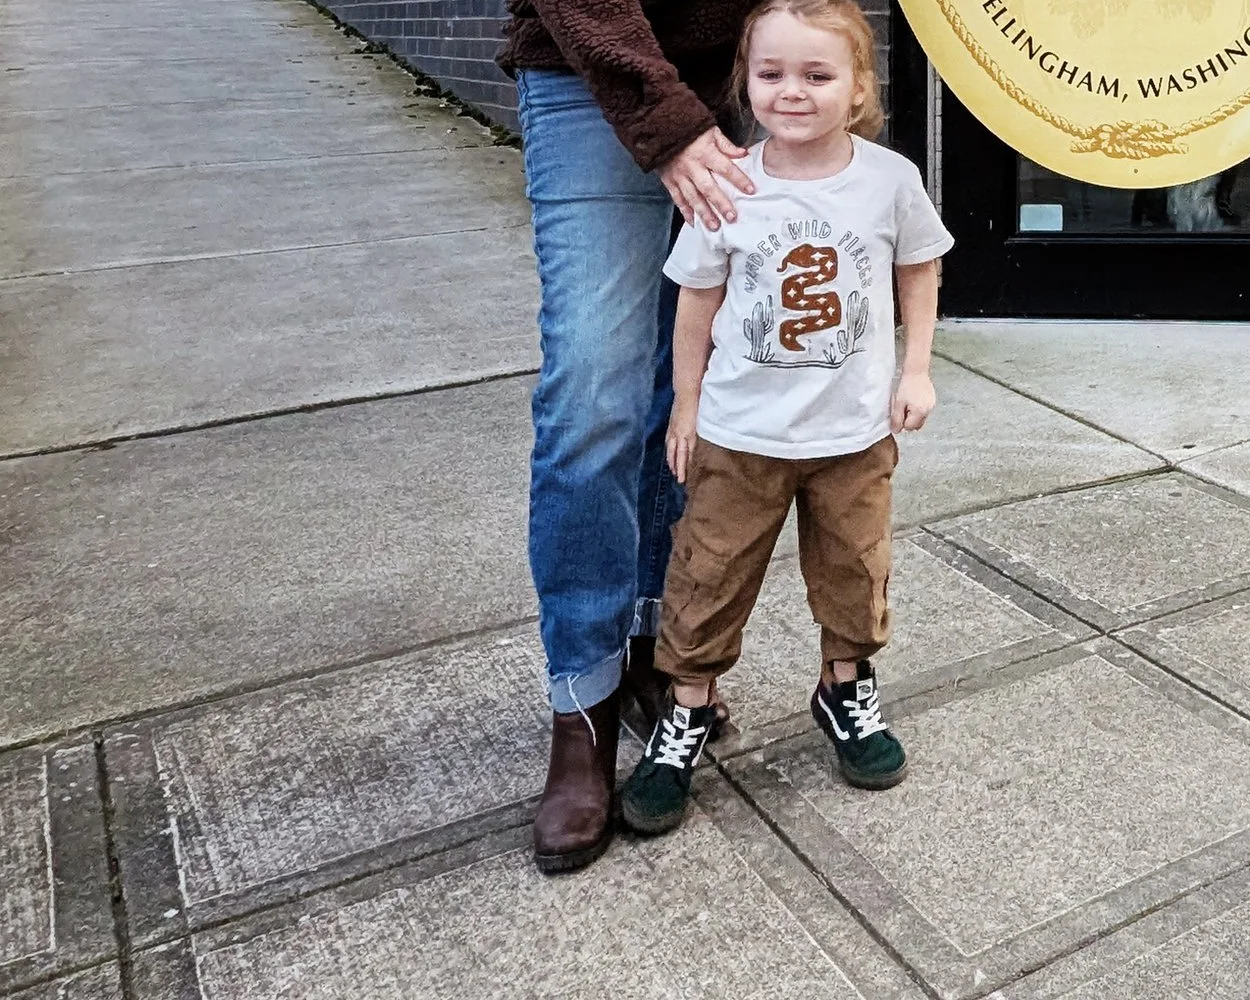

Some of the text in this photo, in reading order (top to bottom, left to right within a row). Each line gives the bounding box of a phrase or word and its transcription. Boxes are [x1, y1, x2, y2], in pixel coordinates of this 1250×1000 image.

[744, 219, 873, 293] WANDER WILD PLACES
